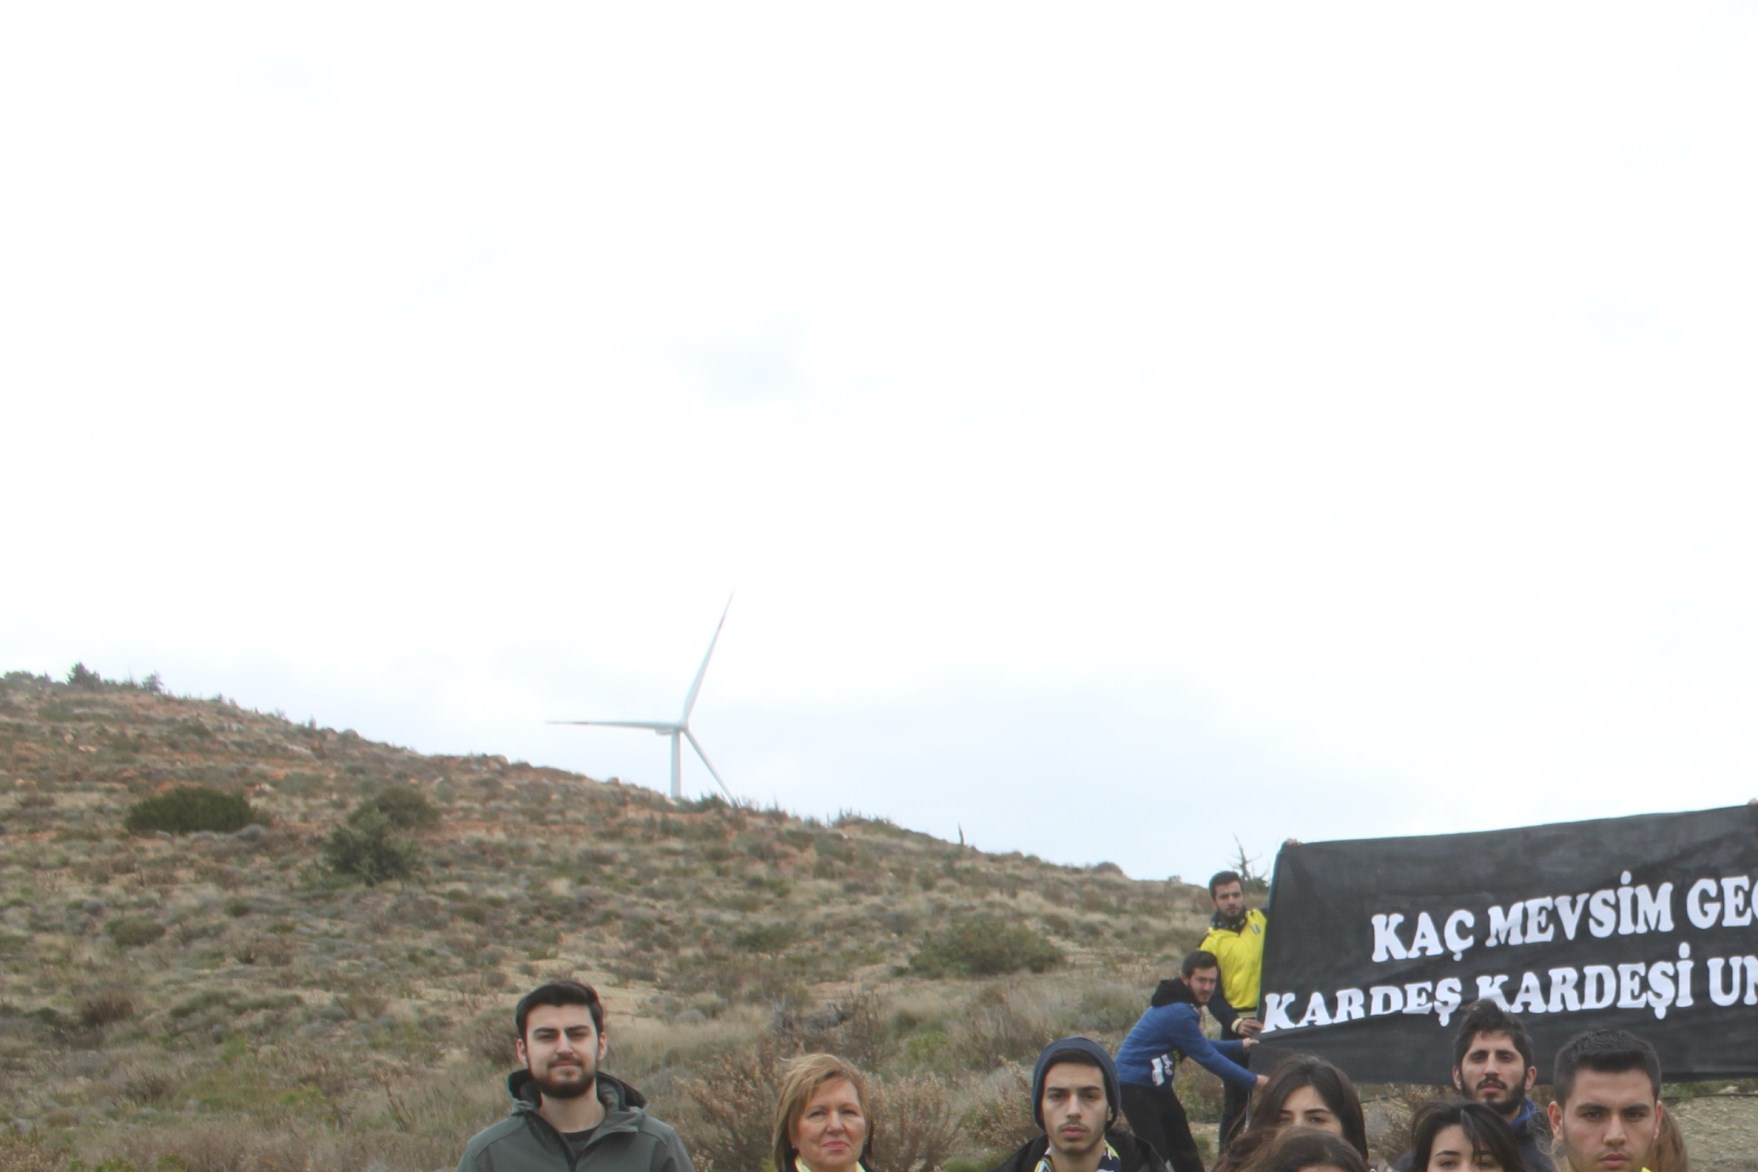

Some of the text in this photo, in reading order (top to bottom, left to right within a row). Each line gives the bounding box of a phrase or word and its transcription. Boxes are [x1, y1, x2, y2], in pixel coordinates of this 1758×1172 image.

[1371, 908, 1475, 962] KAÇ
[1485, 870, 1675, 948] MEVSİM
[1260, 976, 1462, 1034] KARDEŞ
[1475, 941, 1695, 1020] KARDEŞİ
